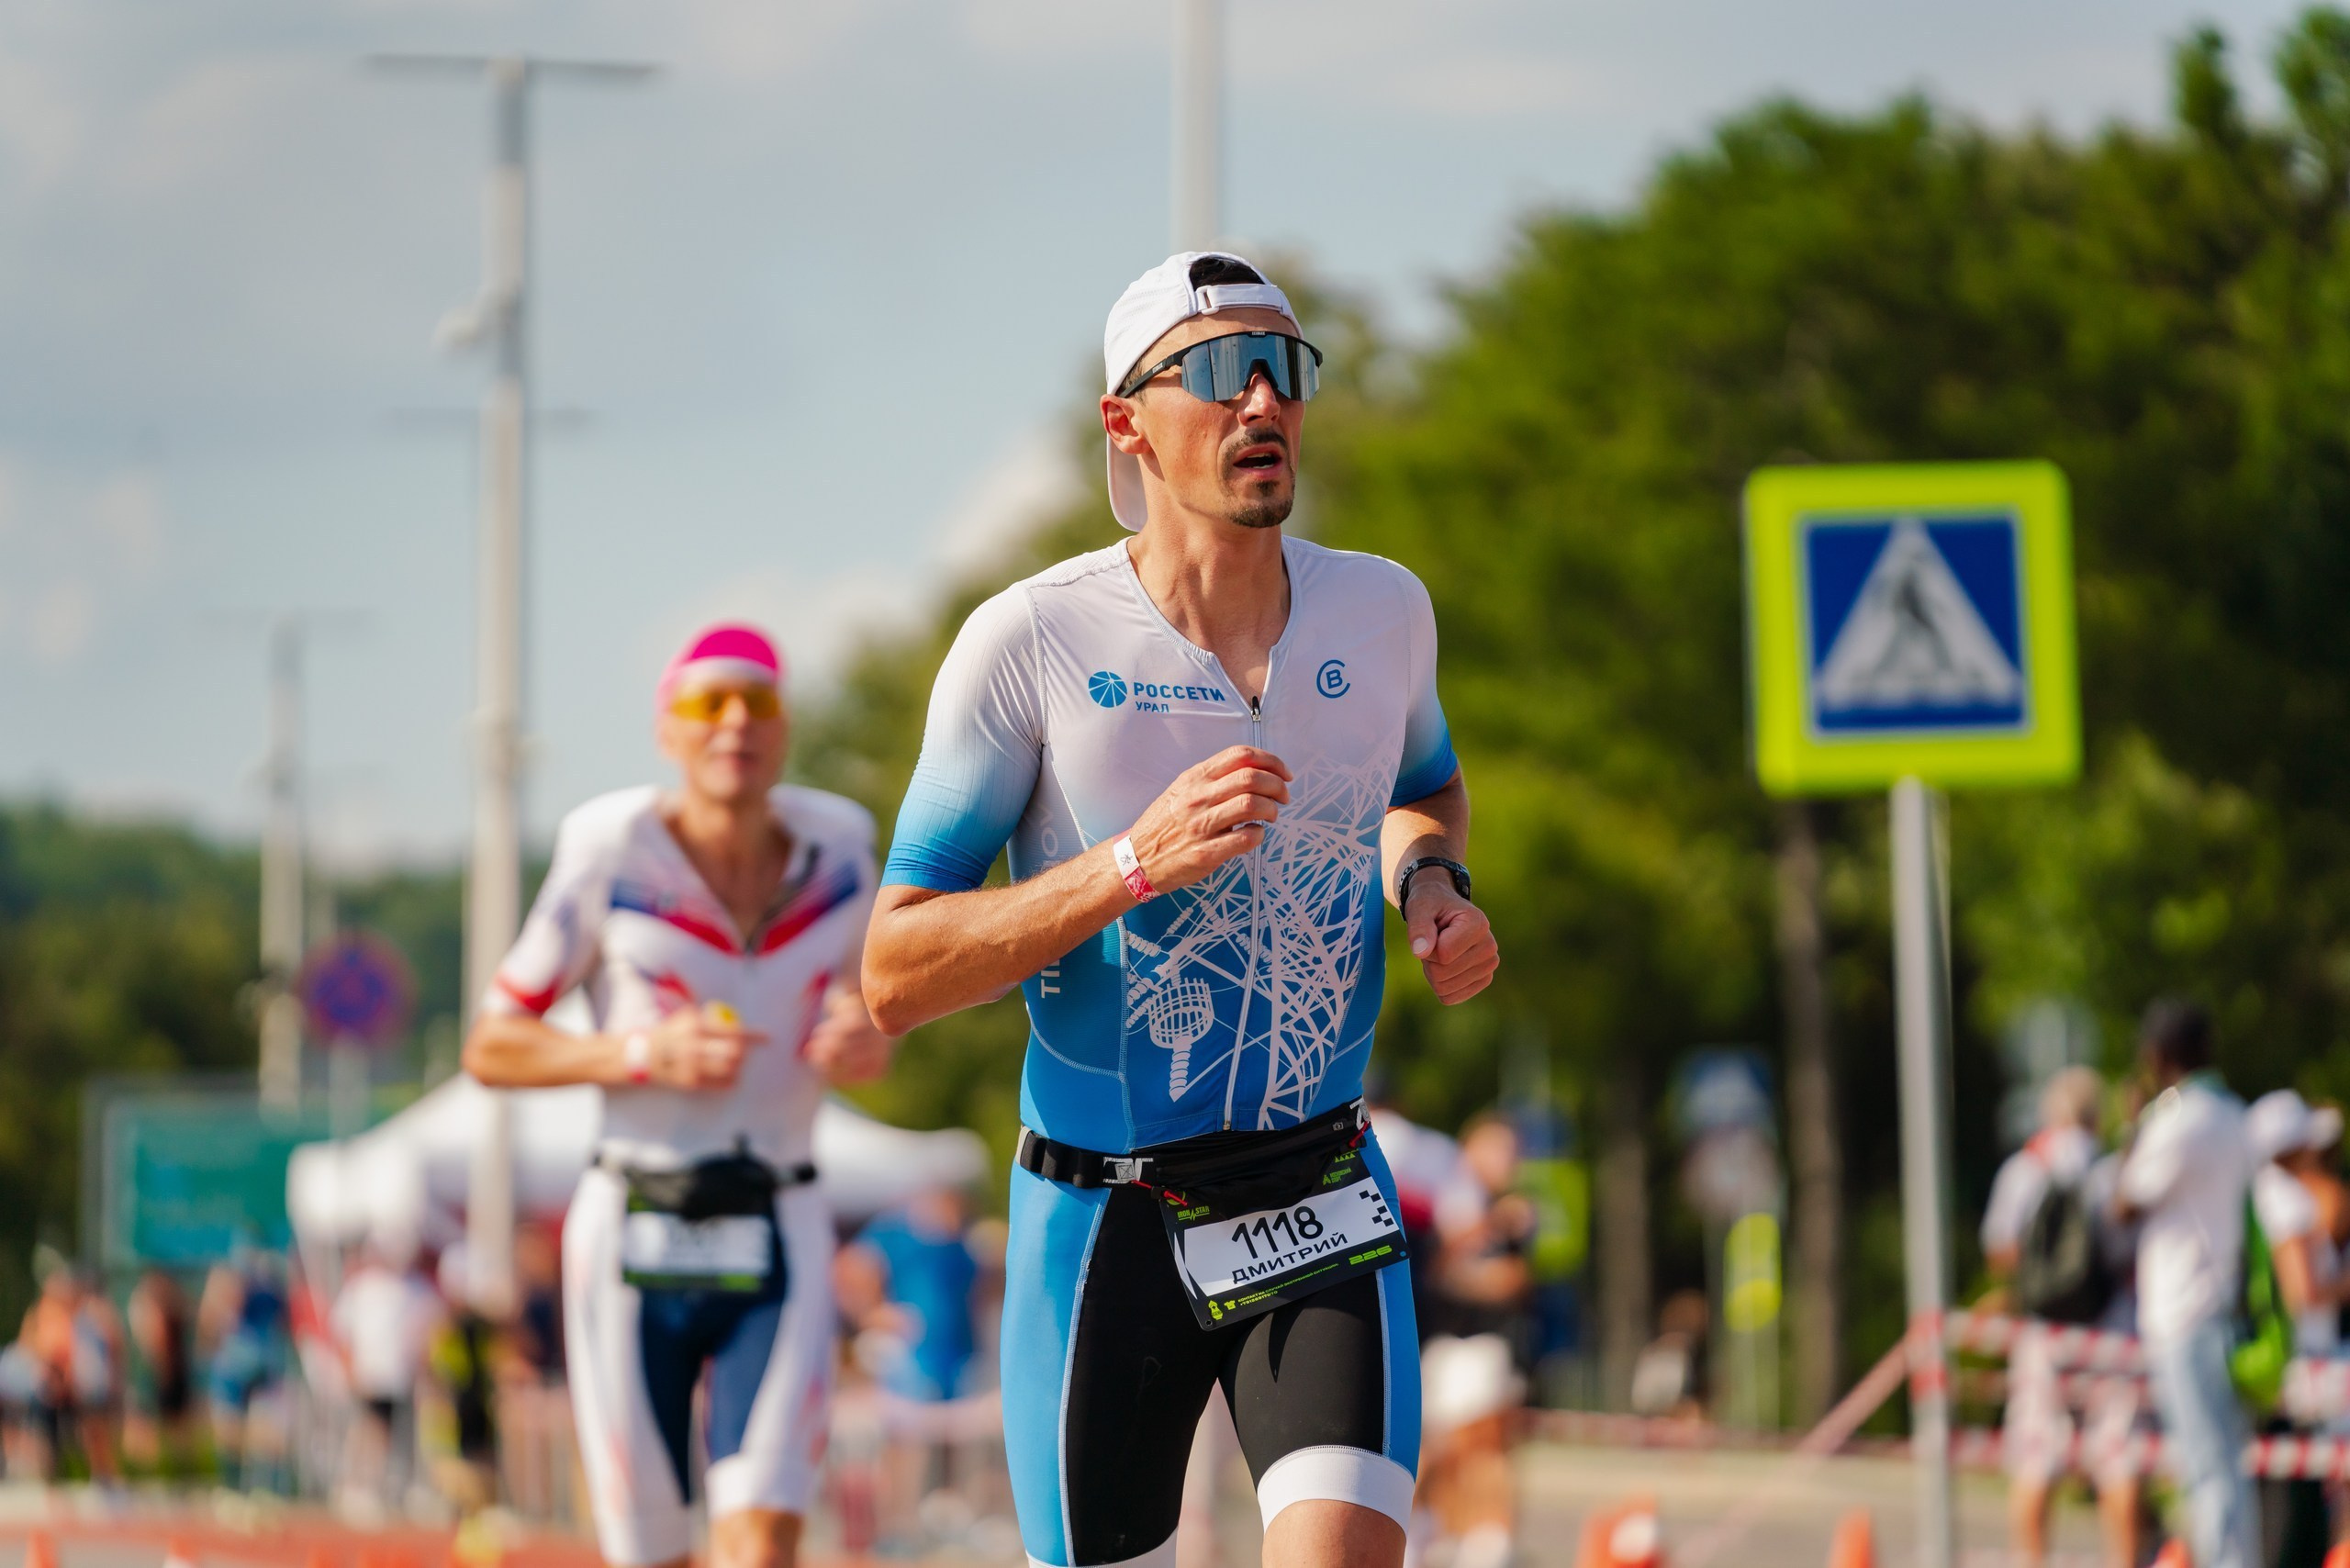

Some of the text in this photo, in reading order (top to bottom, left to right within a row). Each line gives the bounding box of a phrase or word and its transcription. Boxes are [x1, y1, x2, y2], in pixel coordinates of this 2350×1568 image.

[1133, 681, 1226, 701] РОССЕТИ
[1135, 700, 1170, 713] УРАЛ
[1194, 1205, 1210, 1215] STAR
[1231, 1205, 1324, 1260] 1118
[1231, 1231, 1348, 1285] ДМИТРИЙ
[1348, 1245, 1393, 1266] 226
